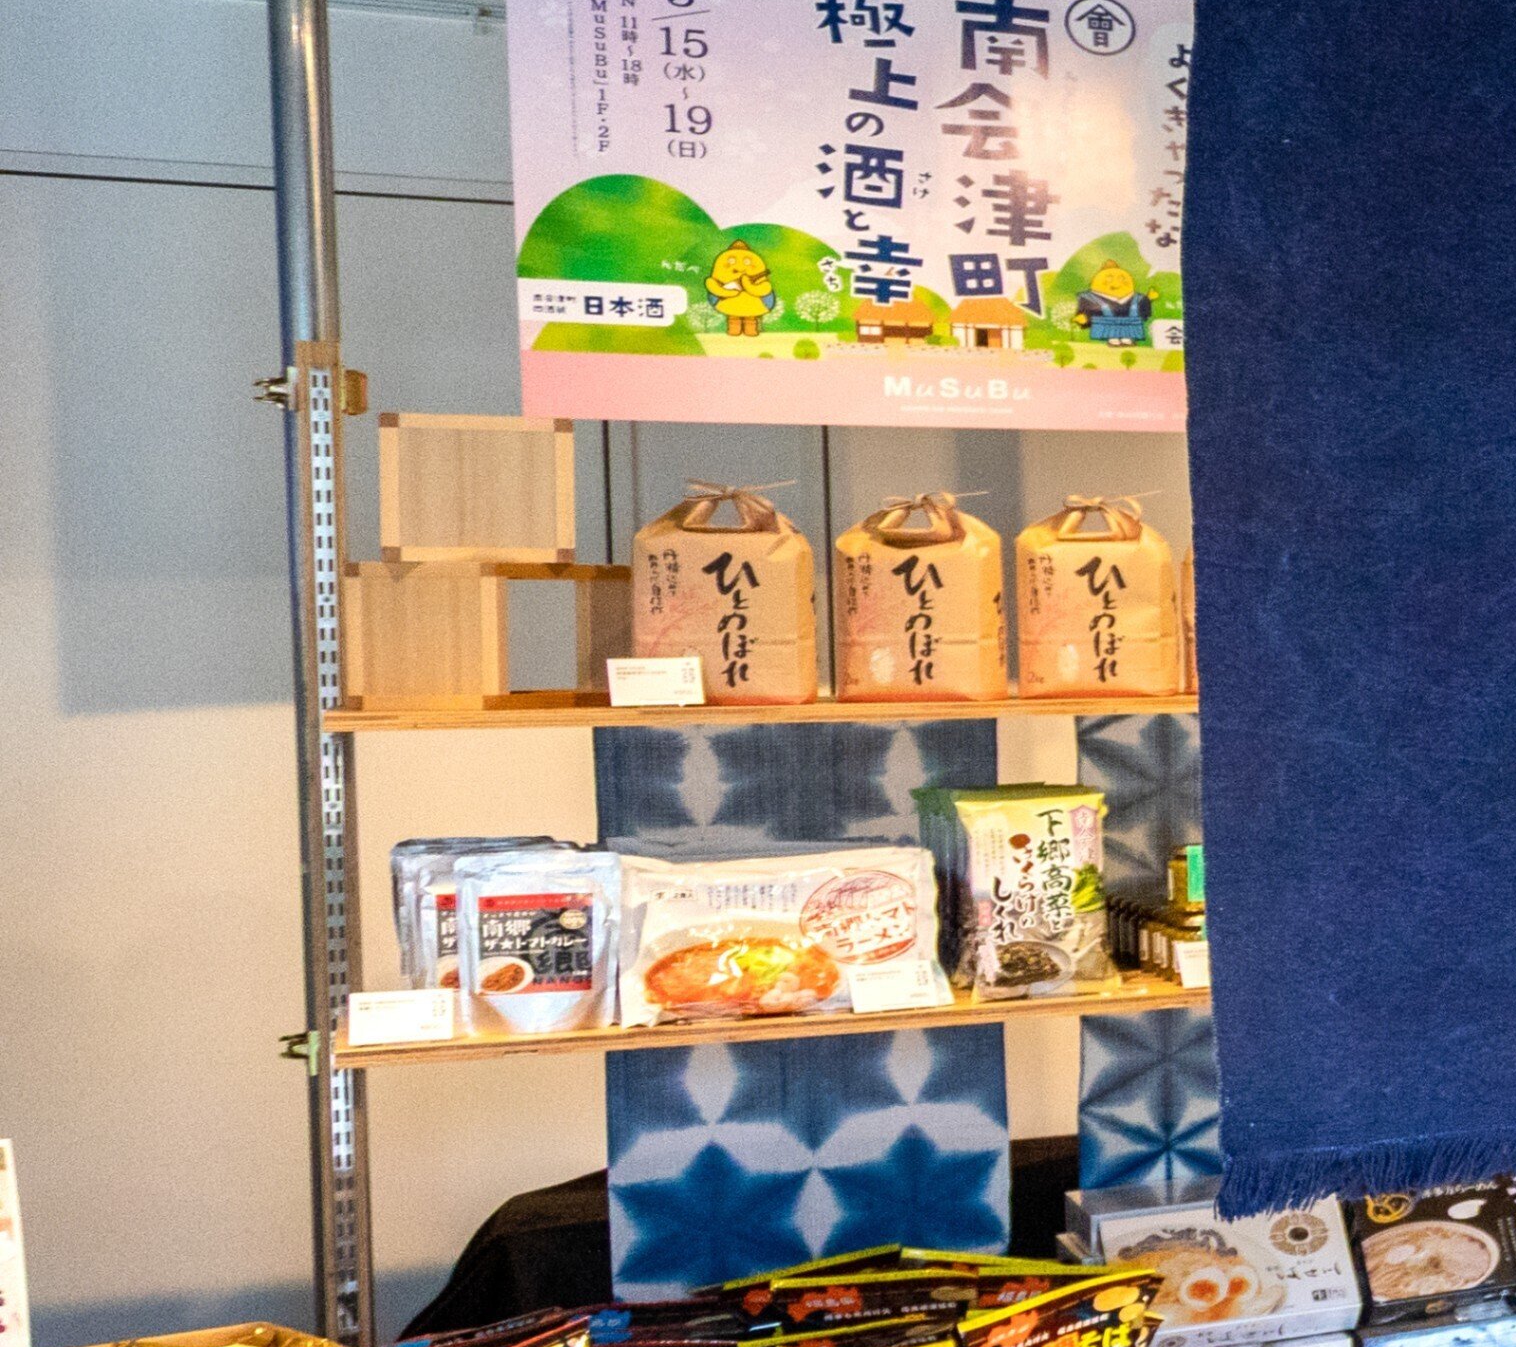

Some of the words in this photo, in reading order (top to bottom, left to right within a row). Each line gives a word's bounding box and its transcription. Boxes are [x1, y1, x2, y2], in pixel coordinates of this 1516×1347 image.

[584, 296, 664, 318] 日本酒
[884, 376, 1031, 401] MuSuBu
